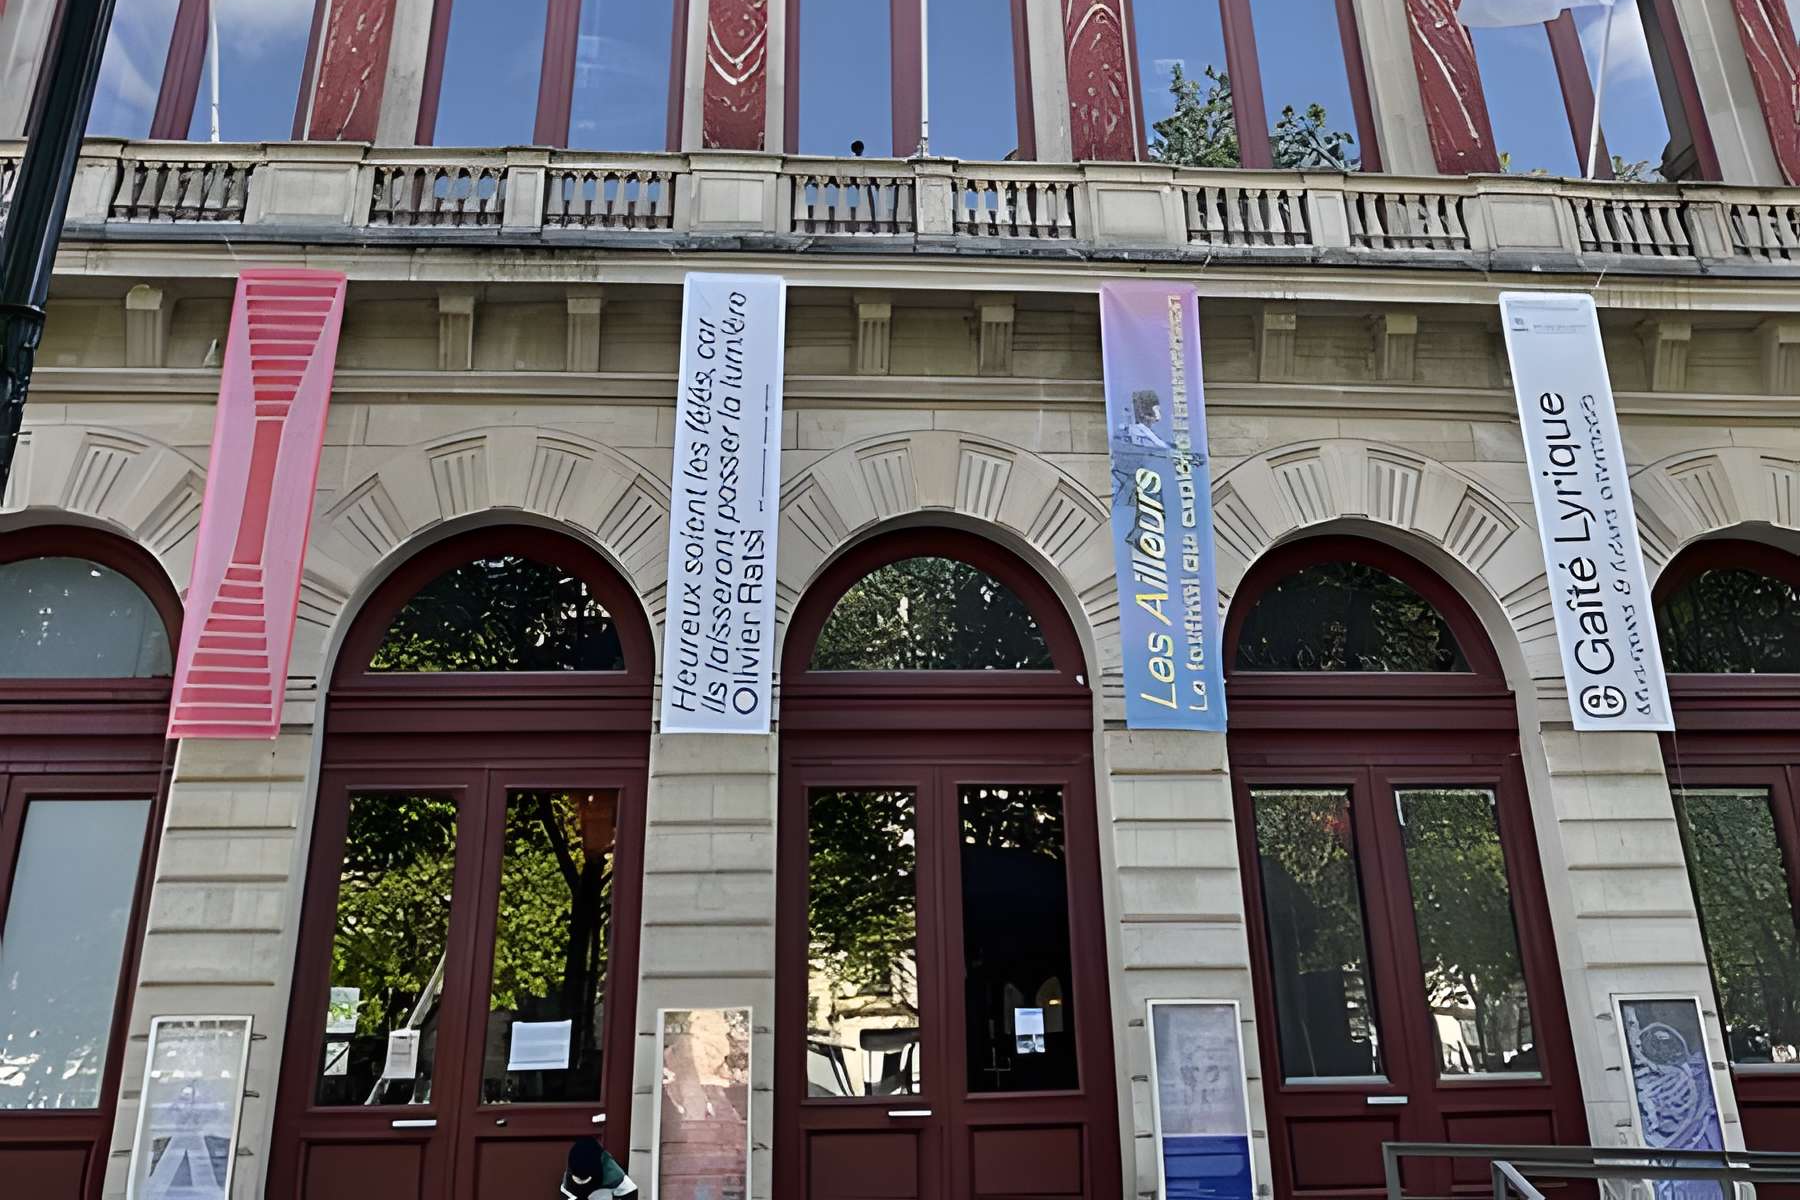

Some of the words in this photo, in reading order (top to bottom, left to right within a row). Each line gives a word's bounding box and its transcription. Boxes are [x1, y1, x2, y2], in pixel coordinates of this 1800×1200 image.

[1536, 390, 1597, 546] Lyrique
[1131, 466, 1174, 627] Ailleurs
[671, 582, 703, 712] Heureux
[1137, 631, 1180, 711] Les
[1557, 556, 1616, 676] Gaîté
